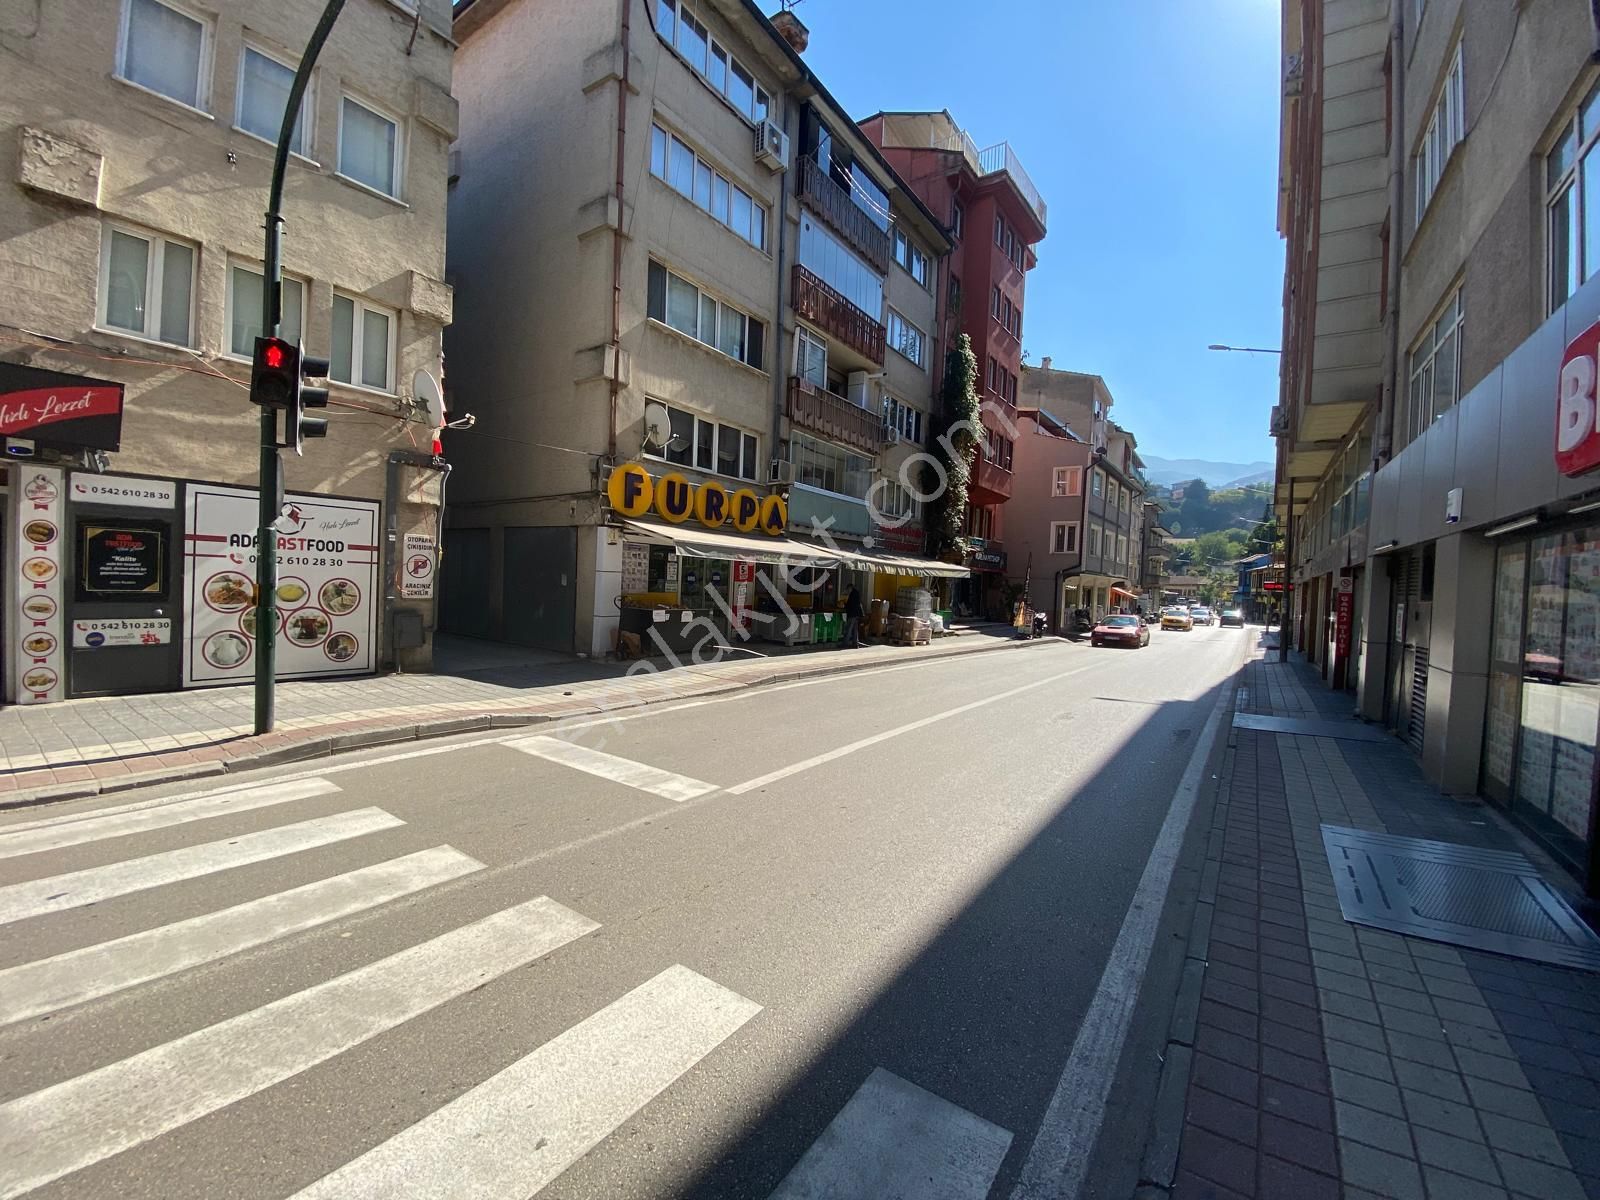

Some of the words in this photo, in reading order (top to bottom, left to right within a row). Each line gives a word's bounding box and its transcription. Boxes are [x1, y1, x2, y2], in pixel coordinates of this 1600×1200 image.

[34, 390, 98, 422] Lezzet
[100, 487, 120, 495] 542
[122, 489, 141, 497] 610
[158, 492, 170, 500] 30
[624, 472, 784, 530] FURPA
[277, 537, 345, 553] ASTFOOD
[249, 555, 256, 563] 0
[287, 557, 309, 565] 610
[312, 558, 326, 566] 28
